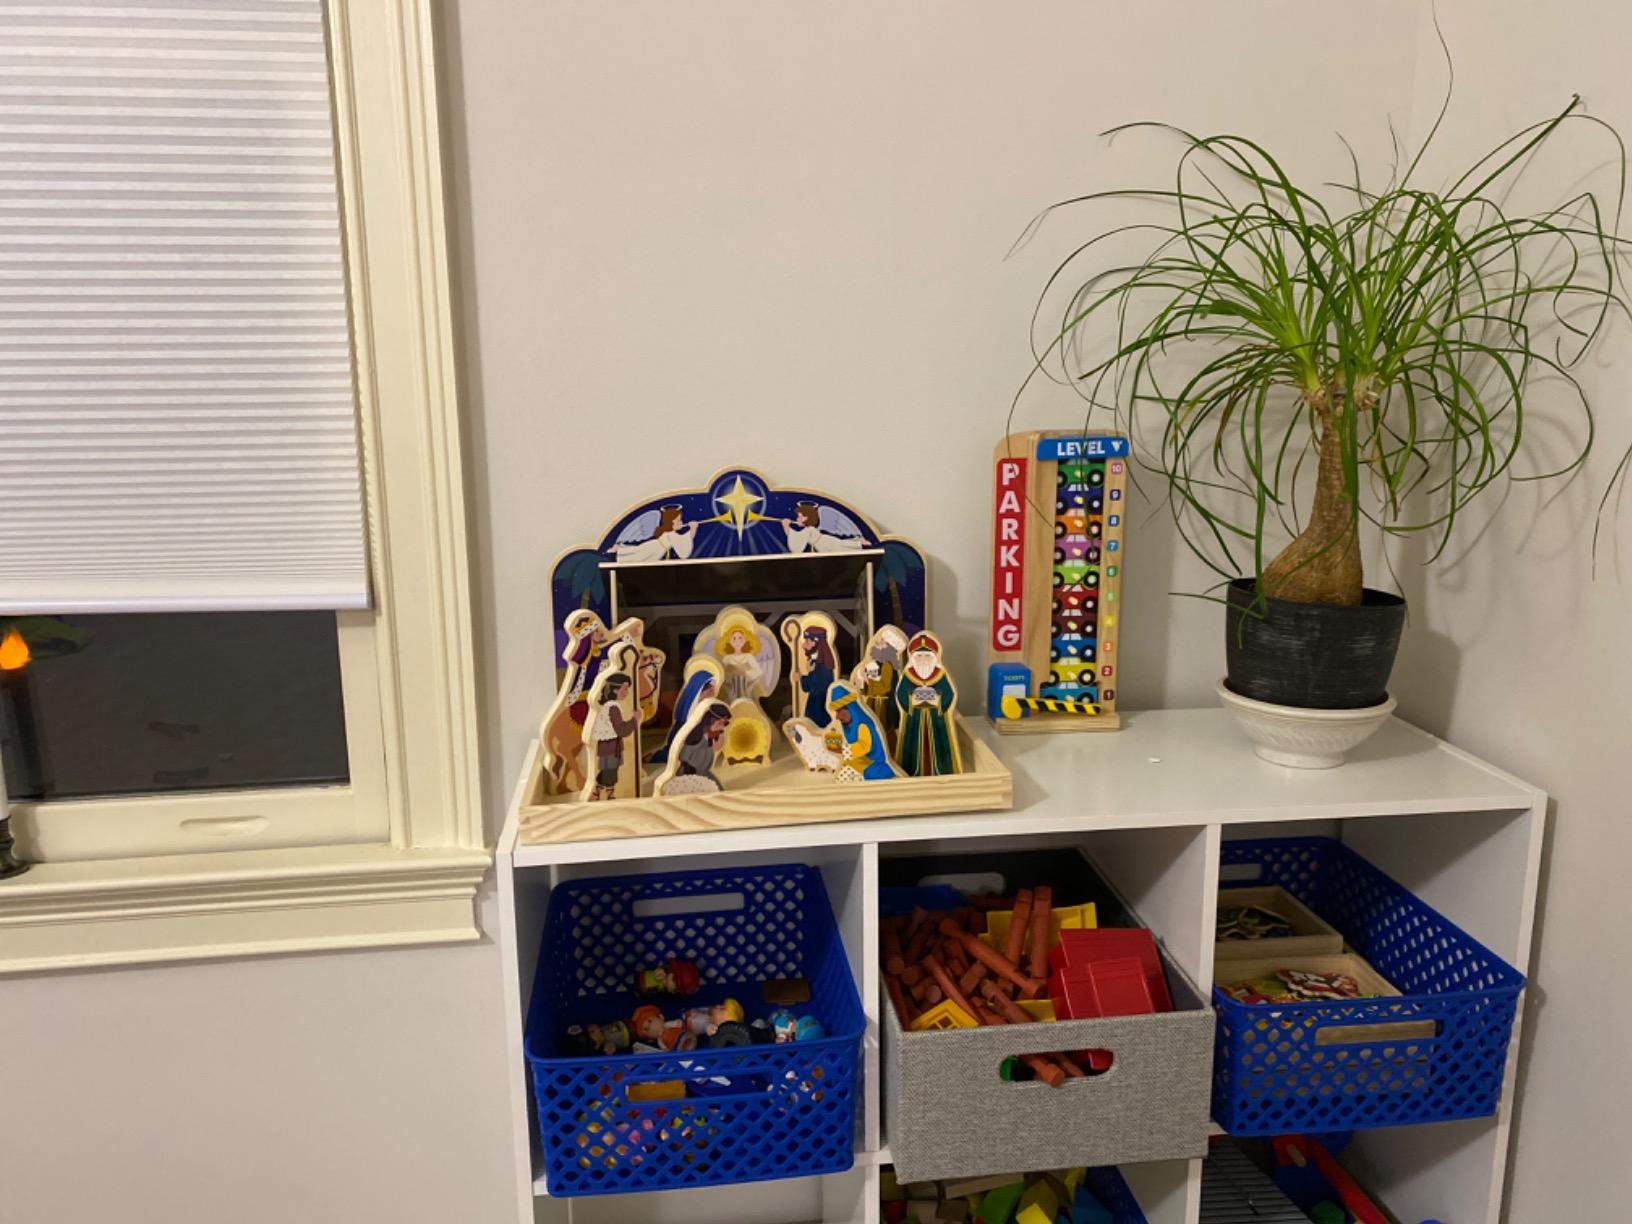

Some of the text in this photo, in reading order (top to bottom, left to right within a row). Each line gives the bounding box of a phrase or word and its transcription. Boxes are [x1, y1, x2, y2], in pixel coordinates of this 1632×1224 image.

[1057, 440, 1105, 456] LEVEL
[1112, 464, 1121, 473] 10
[1112, 490, 1119, 499] 9
[1109, 541, 1117, 550] 7
[998, 462, 1021, 647] PARKING
[1103, 666, 1110, 675] 2
[1106, 691, 1112, 699] 1
